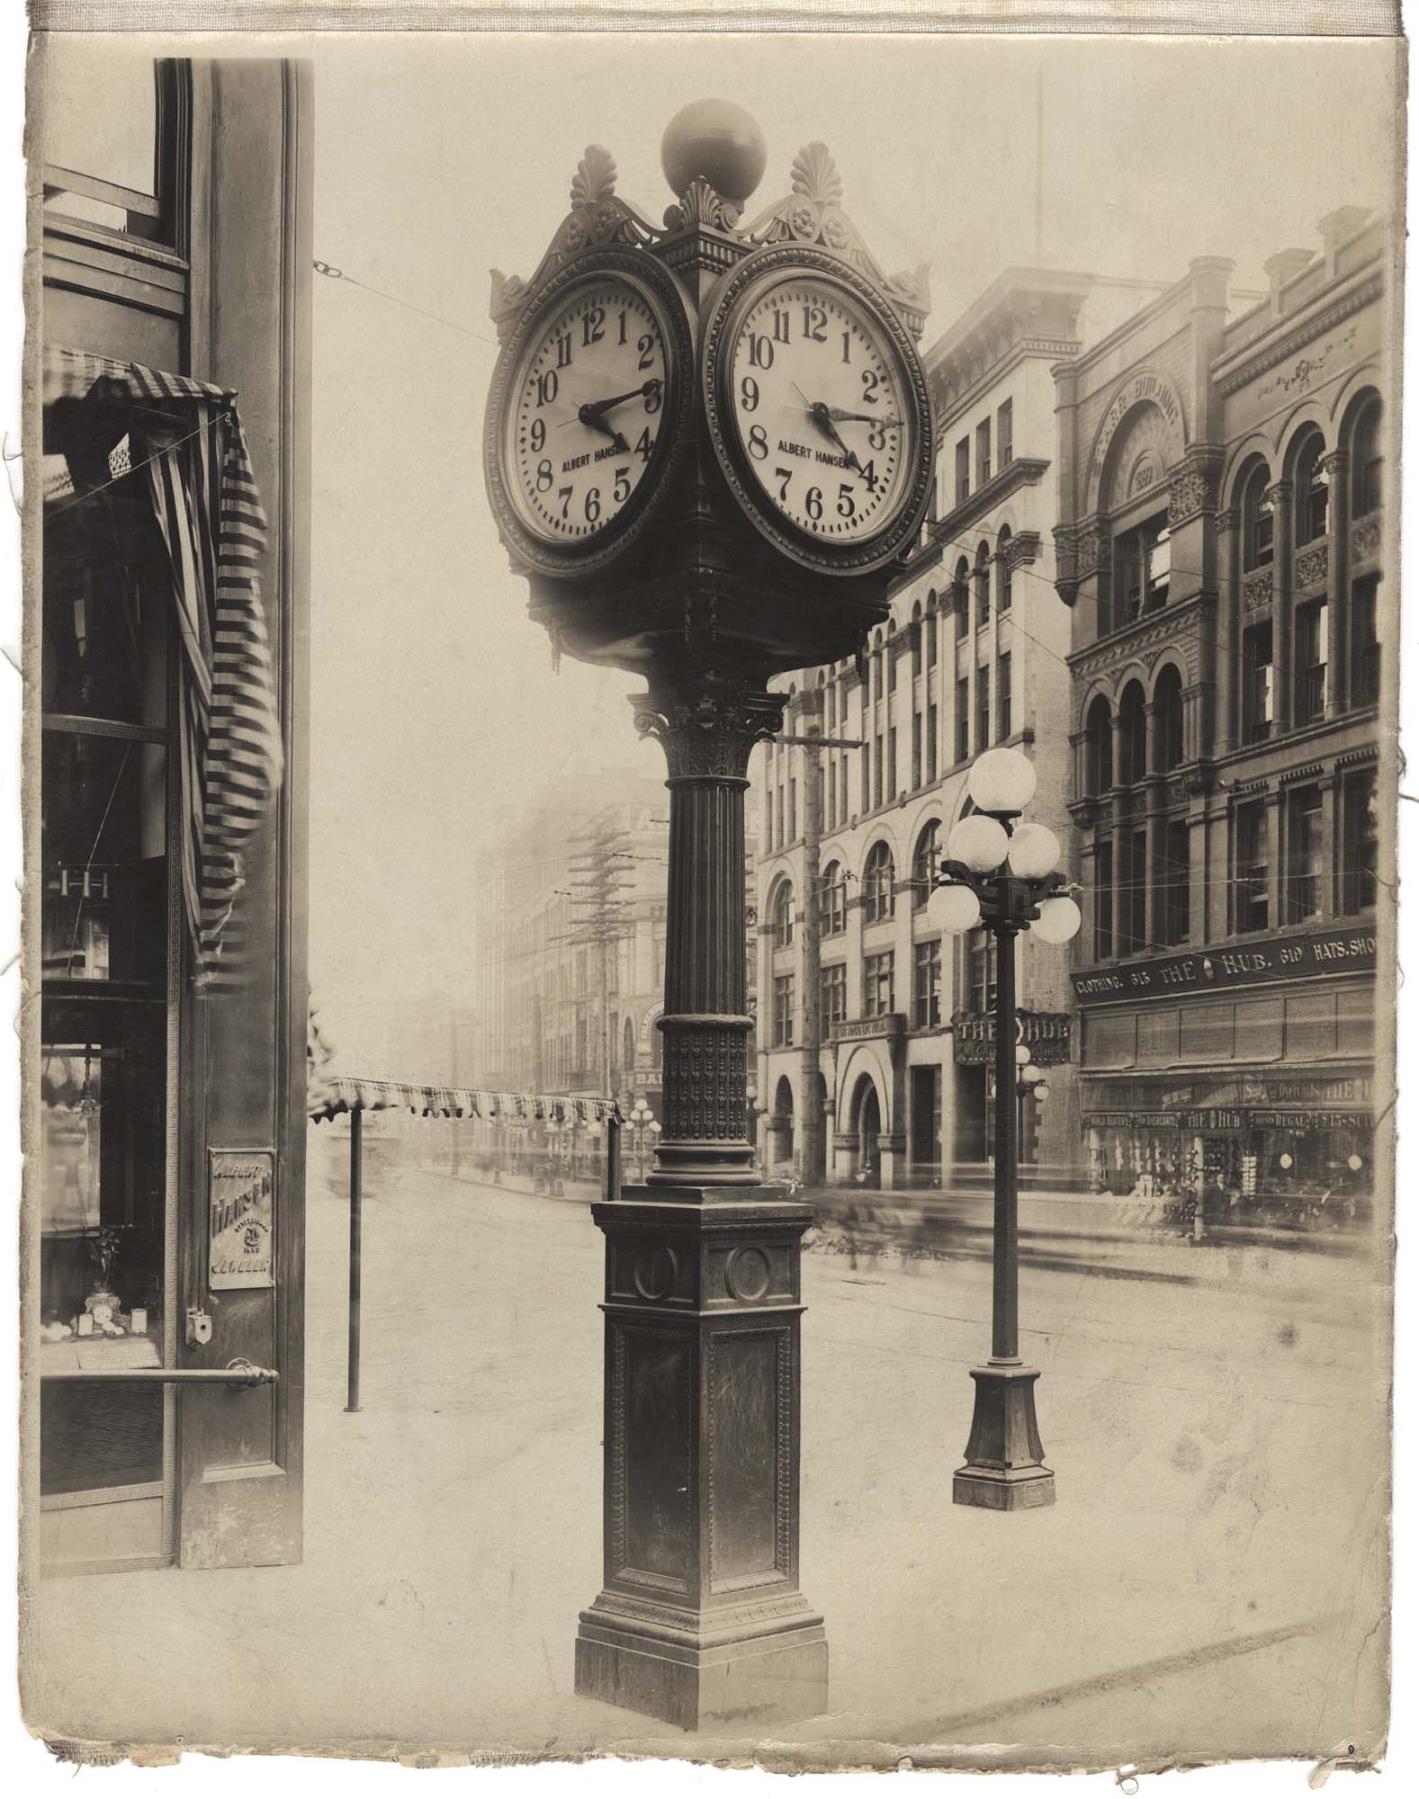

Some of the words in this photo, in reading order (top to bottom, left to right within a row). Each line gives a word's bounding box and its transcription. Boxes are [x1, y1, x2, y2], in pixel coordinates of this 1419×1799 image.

[582, 307, 605, 347] 12
[617, 311, 628, 345] 1
[772, 309, 791, 345] 11
[802, 306, 827, 343] 12
[556, 332, 573, 369] 11
[638, 334, 655, 371] 2
[748, 332, 775, 370] 10
[842, 331, 851, 364] 1
[536, 370, 558, 408] 10
[643, 379, 662, 414] 3
[741, 376, 760, 412] 9
[862, 370, 878, 404] 2
[531, 419, 546, 452] 9
[634, 425, 656, 463] 4
[748, 425, 768, 460] 8
[778, 439, 812, 459] ALBERT
[868, 418, 887, 451] 3
[562, 453, 591, 474] ALBERT
[594, 443, 624, 463] HANS
[536, 459, 553, 493] 8
[614, 467, 631, 503] 5
[775, 467, 793, 501] 7
[859, 459, 879, 493] 4
[558, 485, 573, 519] 7
[584, 488, 600, 522] 6
[805, 486, 823, 520] 6
[837, 483, 855, 518] 5
[1160, 960, 1197, 984] THE
[958, 1020, 997, 1041] THE
